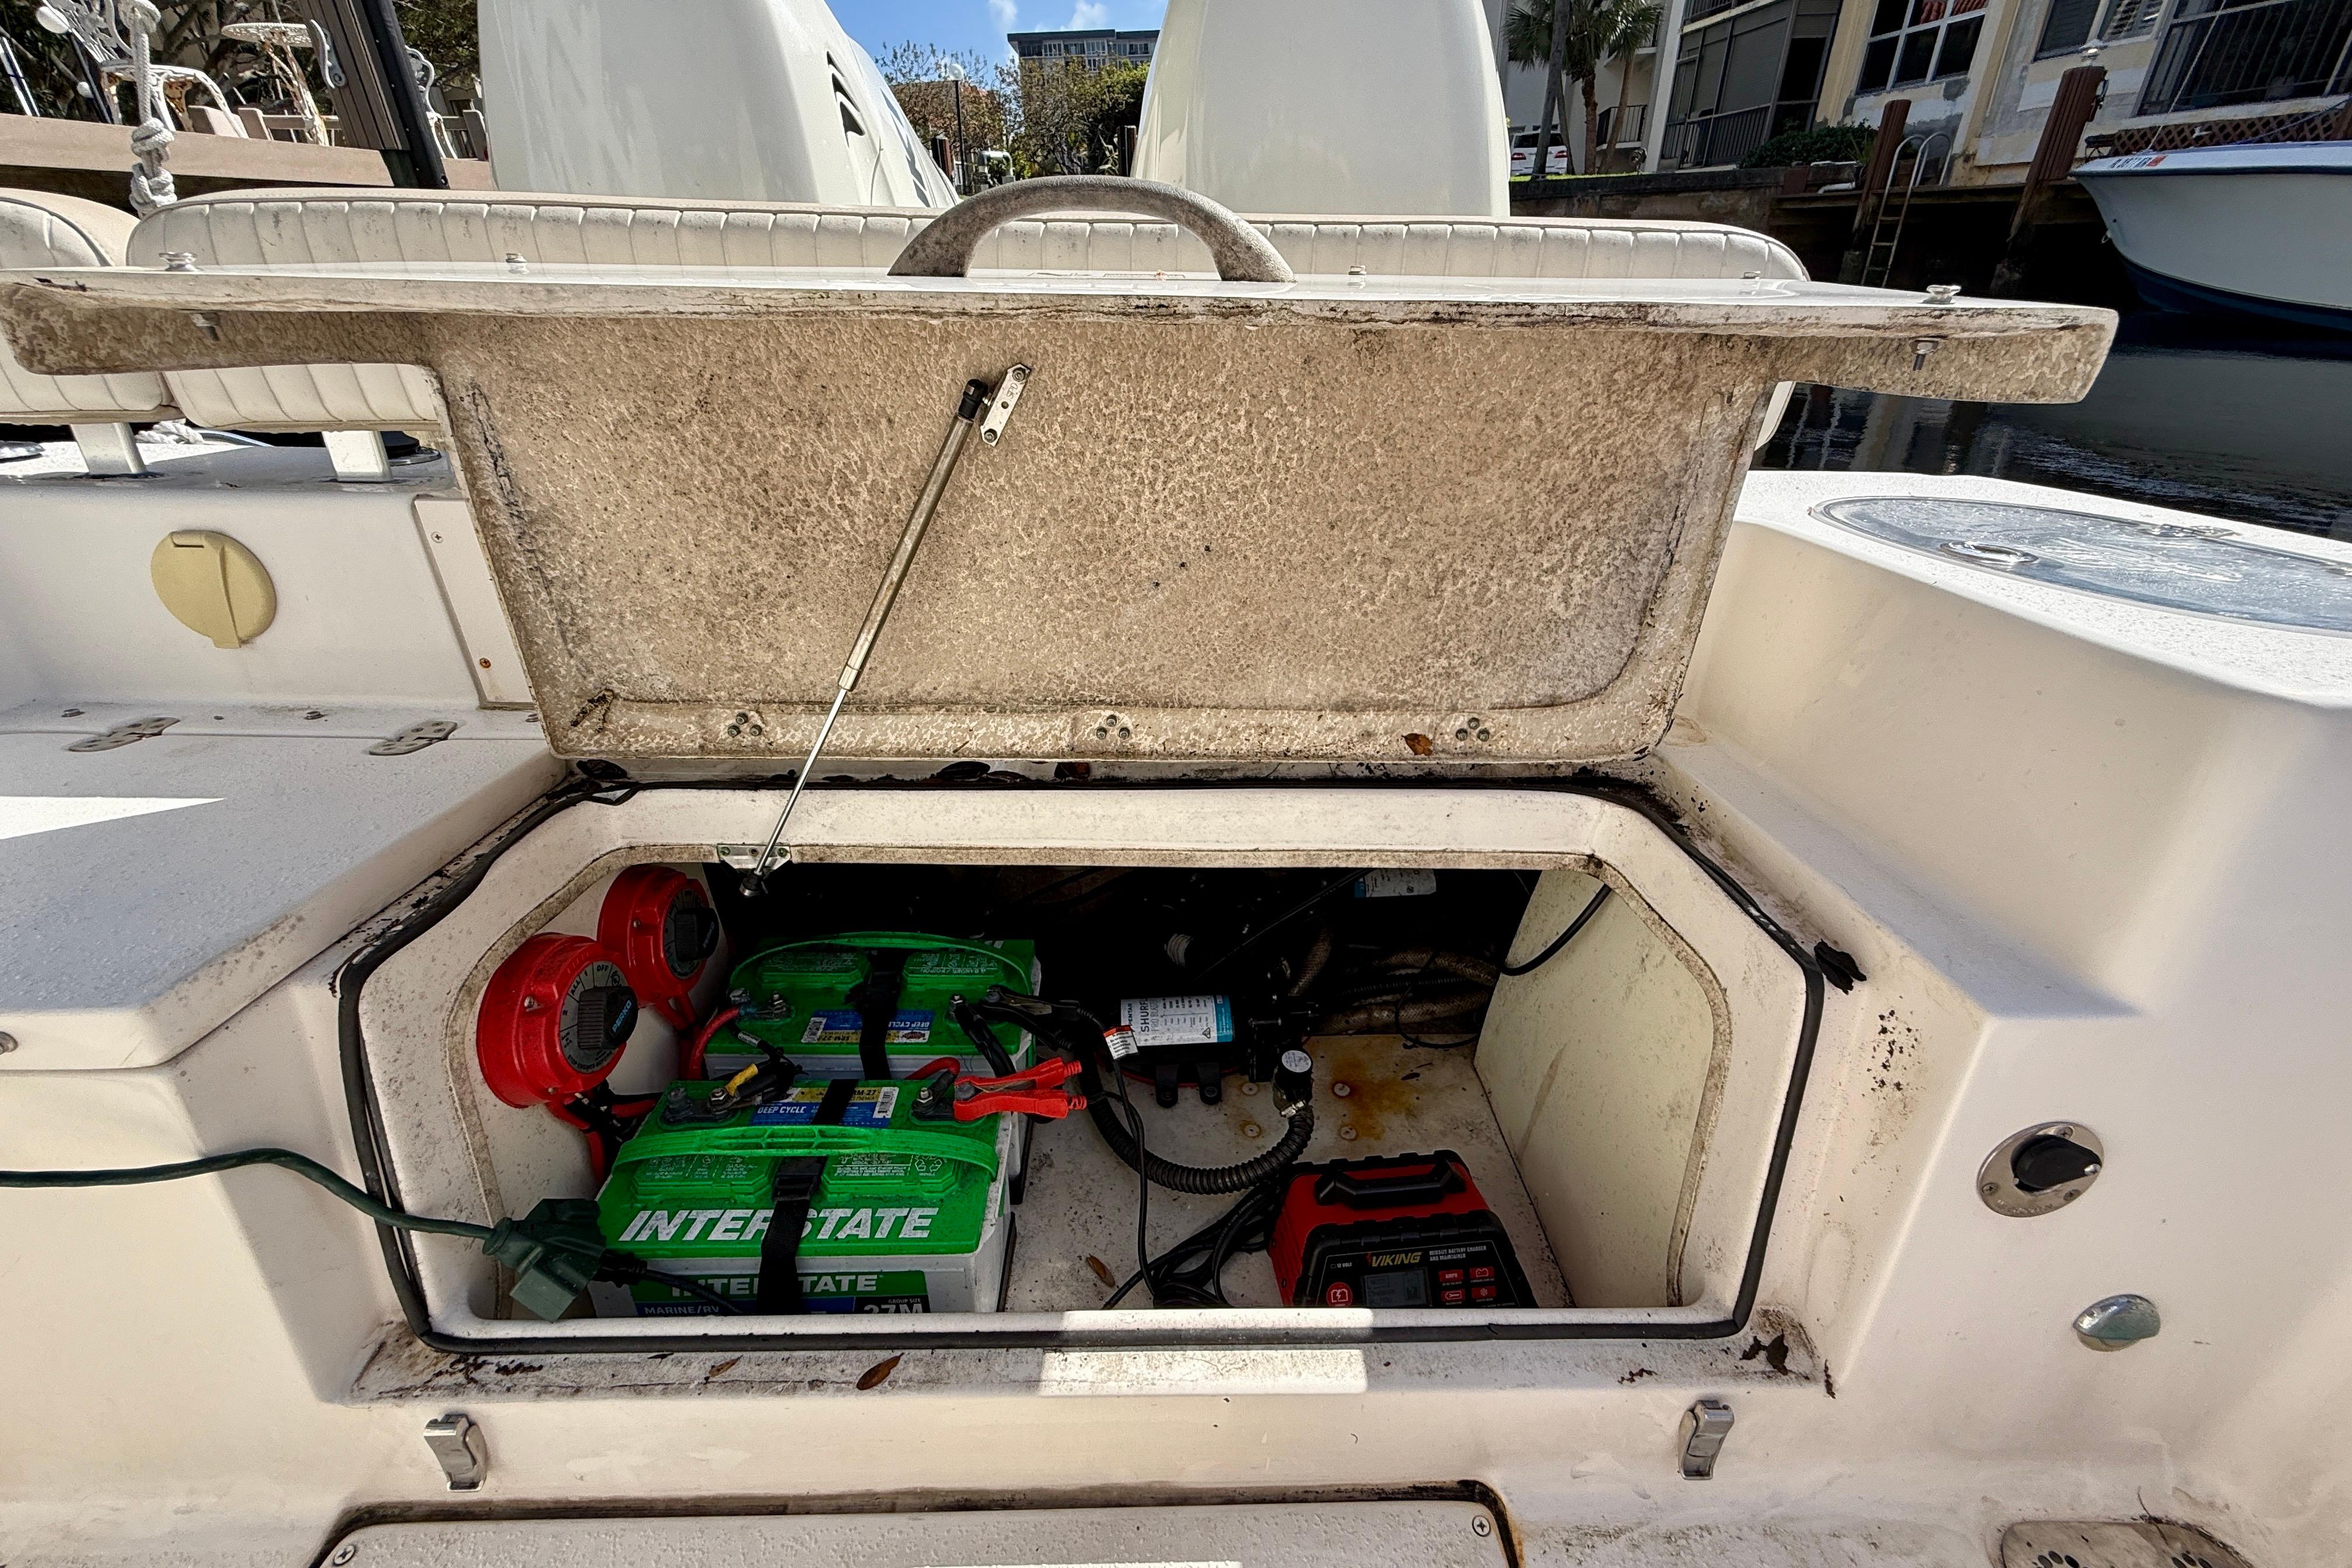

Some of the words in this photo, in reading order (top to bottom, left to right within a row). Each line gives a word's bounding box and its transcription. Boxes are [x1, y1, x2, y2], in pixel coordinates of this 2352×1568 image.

[1007, 383, 1017, 399] SPD
[596, 964, 609, 972] OFF
[571, 979, 580, 996] ALL
[1140, 997, 1150, 1032] SHURFL
[1150, 998, 1158, 1016] BLASTE
[611, 999, 632, 1033] PERKO
[1150, 1016, 1159, 1032] PRO
[568, 1055, 578, 1065] STOP
[757, 1106, 779, 1114] DEEP
[779, 1106, 807, 1114] CYCLE
[1371, 1252, 1422, 1267] VIKING
[644, 1304, 720, 1315] MARINE/RV
